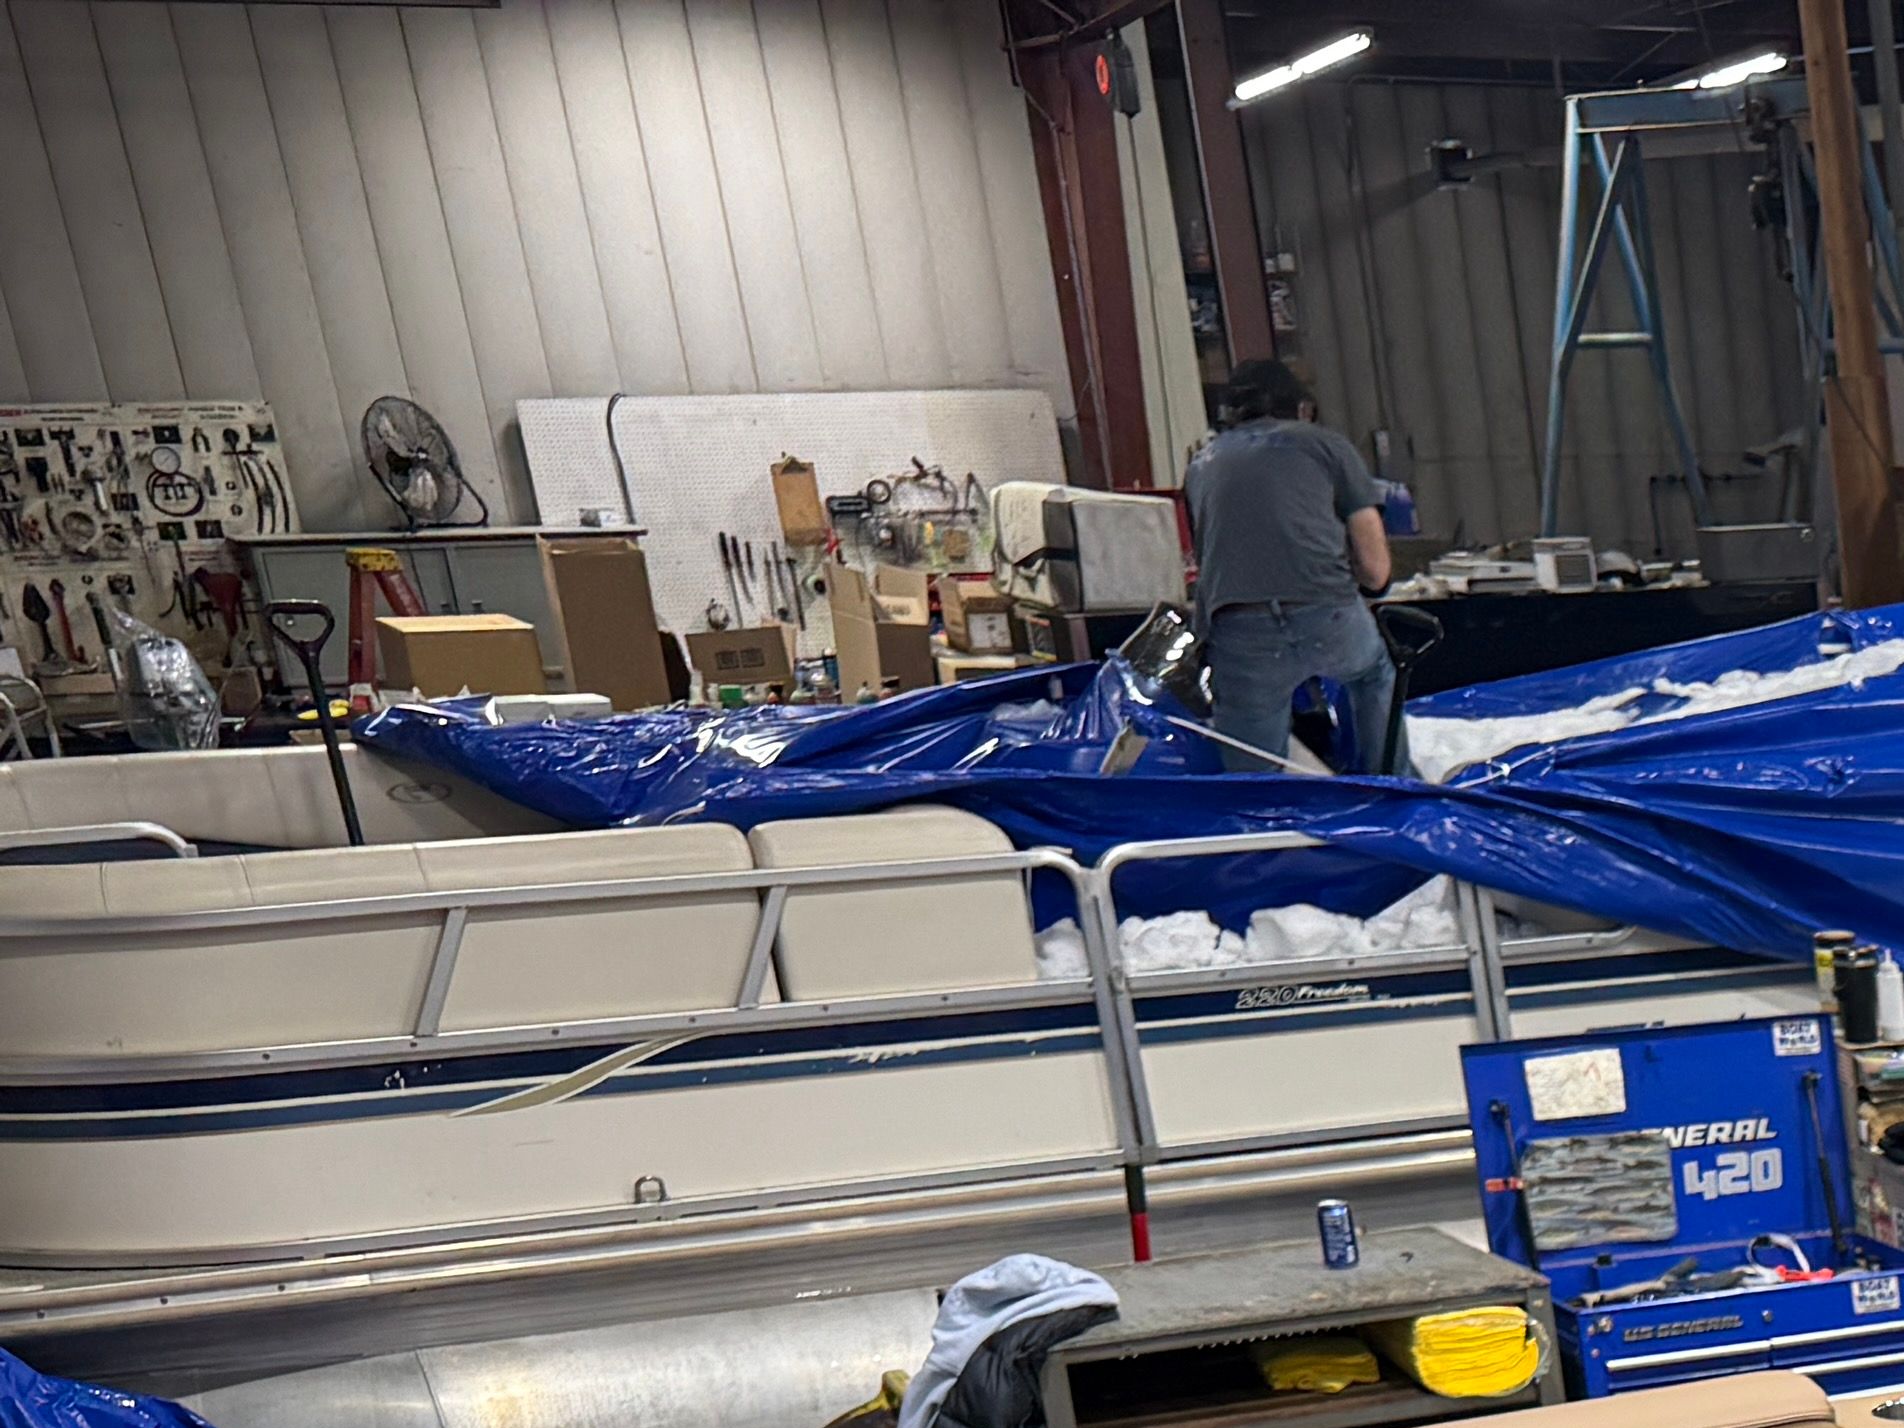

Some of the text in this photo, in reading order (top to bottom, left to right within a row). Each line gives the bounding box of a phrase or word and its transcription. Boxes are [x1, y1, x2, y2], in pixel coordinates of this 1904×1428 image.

[1297, 983, 1369, 1001] Freedom
[1640, 1117, 1778, 1149] NERAL
[1682, 1147, 1783, 1201] 420
